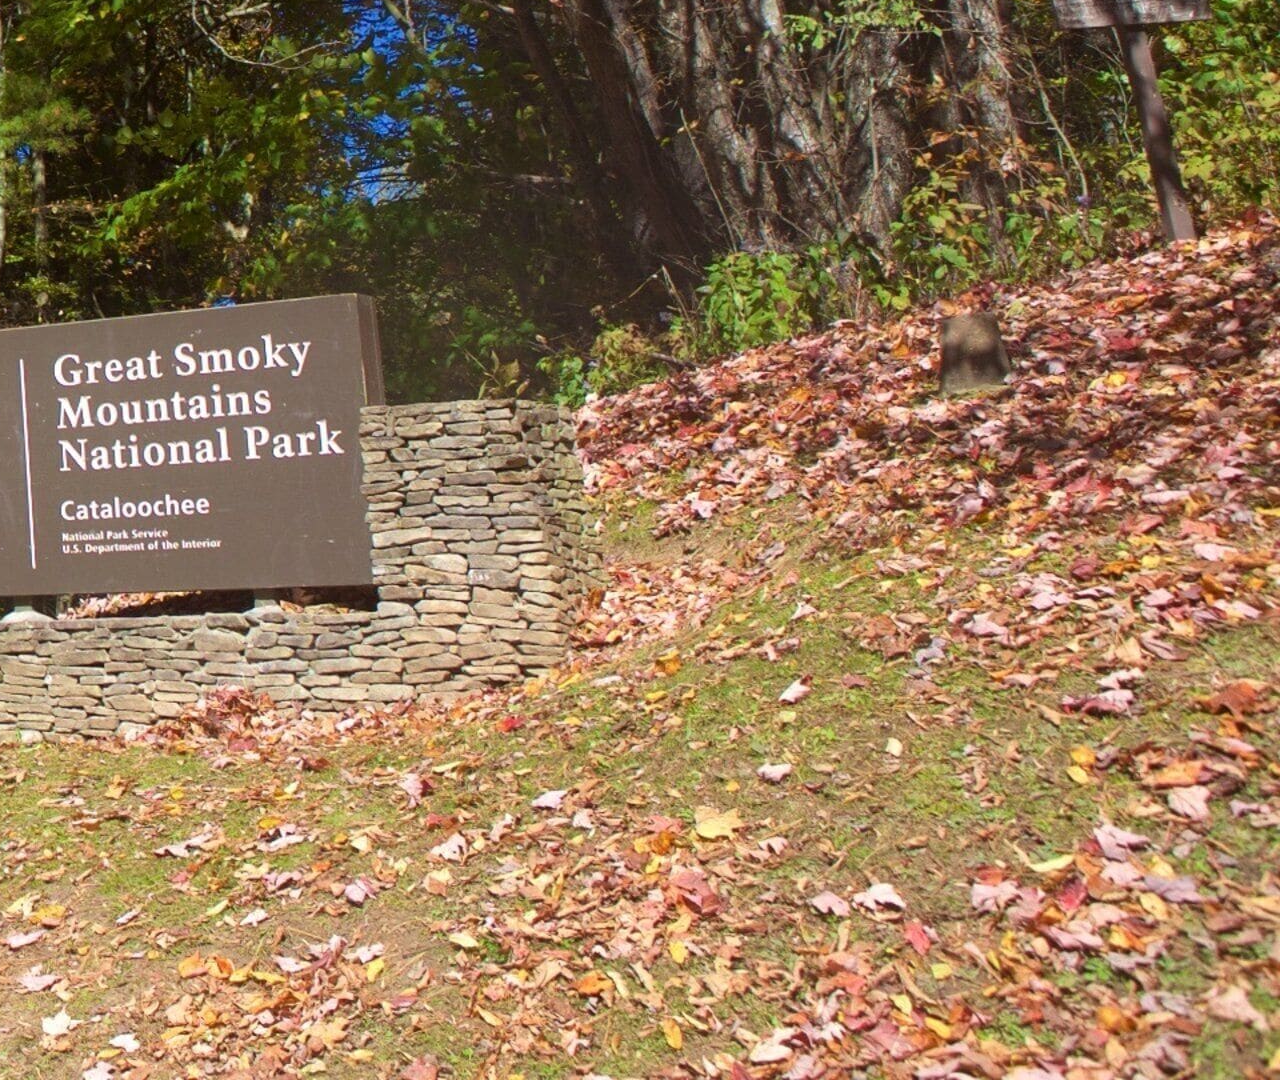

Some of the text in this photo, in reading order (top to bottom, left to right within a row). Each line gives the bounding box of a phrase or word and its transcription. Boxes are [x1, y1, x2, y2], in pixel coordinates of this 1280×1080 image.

[53, 333, 312, 387] Great Smoky
[56, 383, 272, 430] Mountains
[58, 419, 345, 472] National Park
[60, 493, 210, 521] Cataloochee
[61, 528, 169, 542] National Park Service
[62, 537, 222, 555] U.S. Department of the Interior
